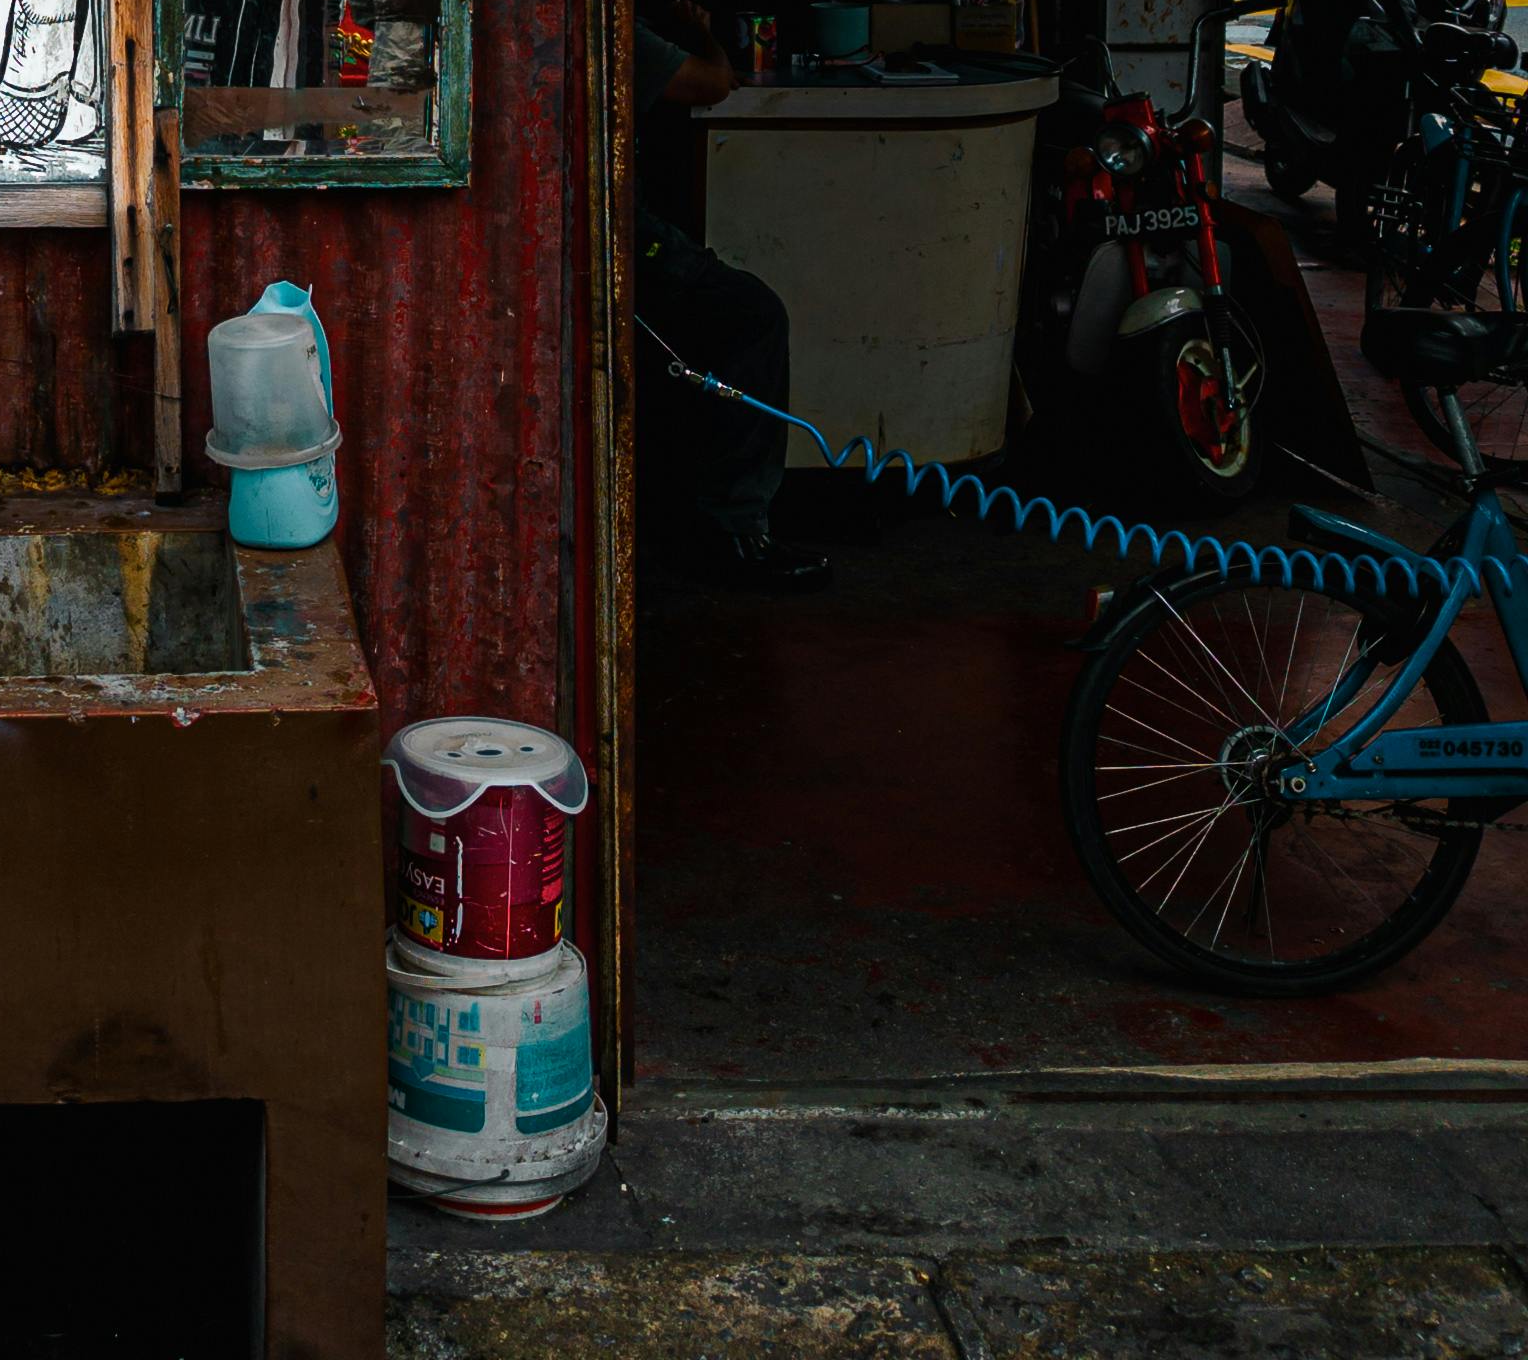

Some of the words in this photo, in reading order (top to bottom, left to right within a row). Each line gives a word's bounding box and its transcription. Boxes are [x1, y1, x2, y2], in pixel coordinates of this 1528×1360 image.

[1105, 214, 1141, 236] PAJ
[1144, 206, 1199, 231] 3925
[1443, 740, 1523, 757] 045730
